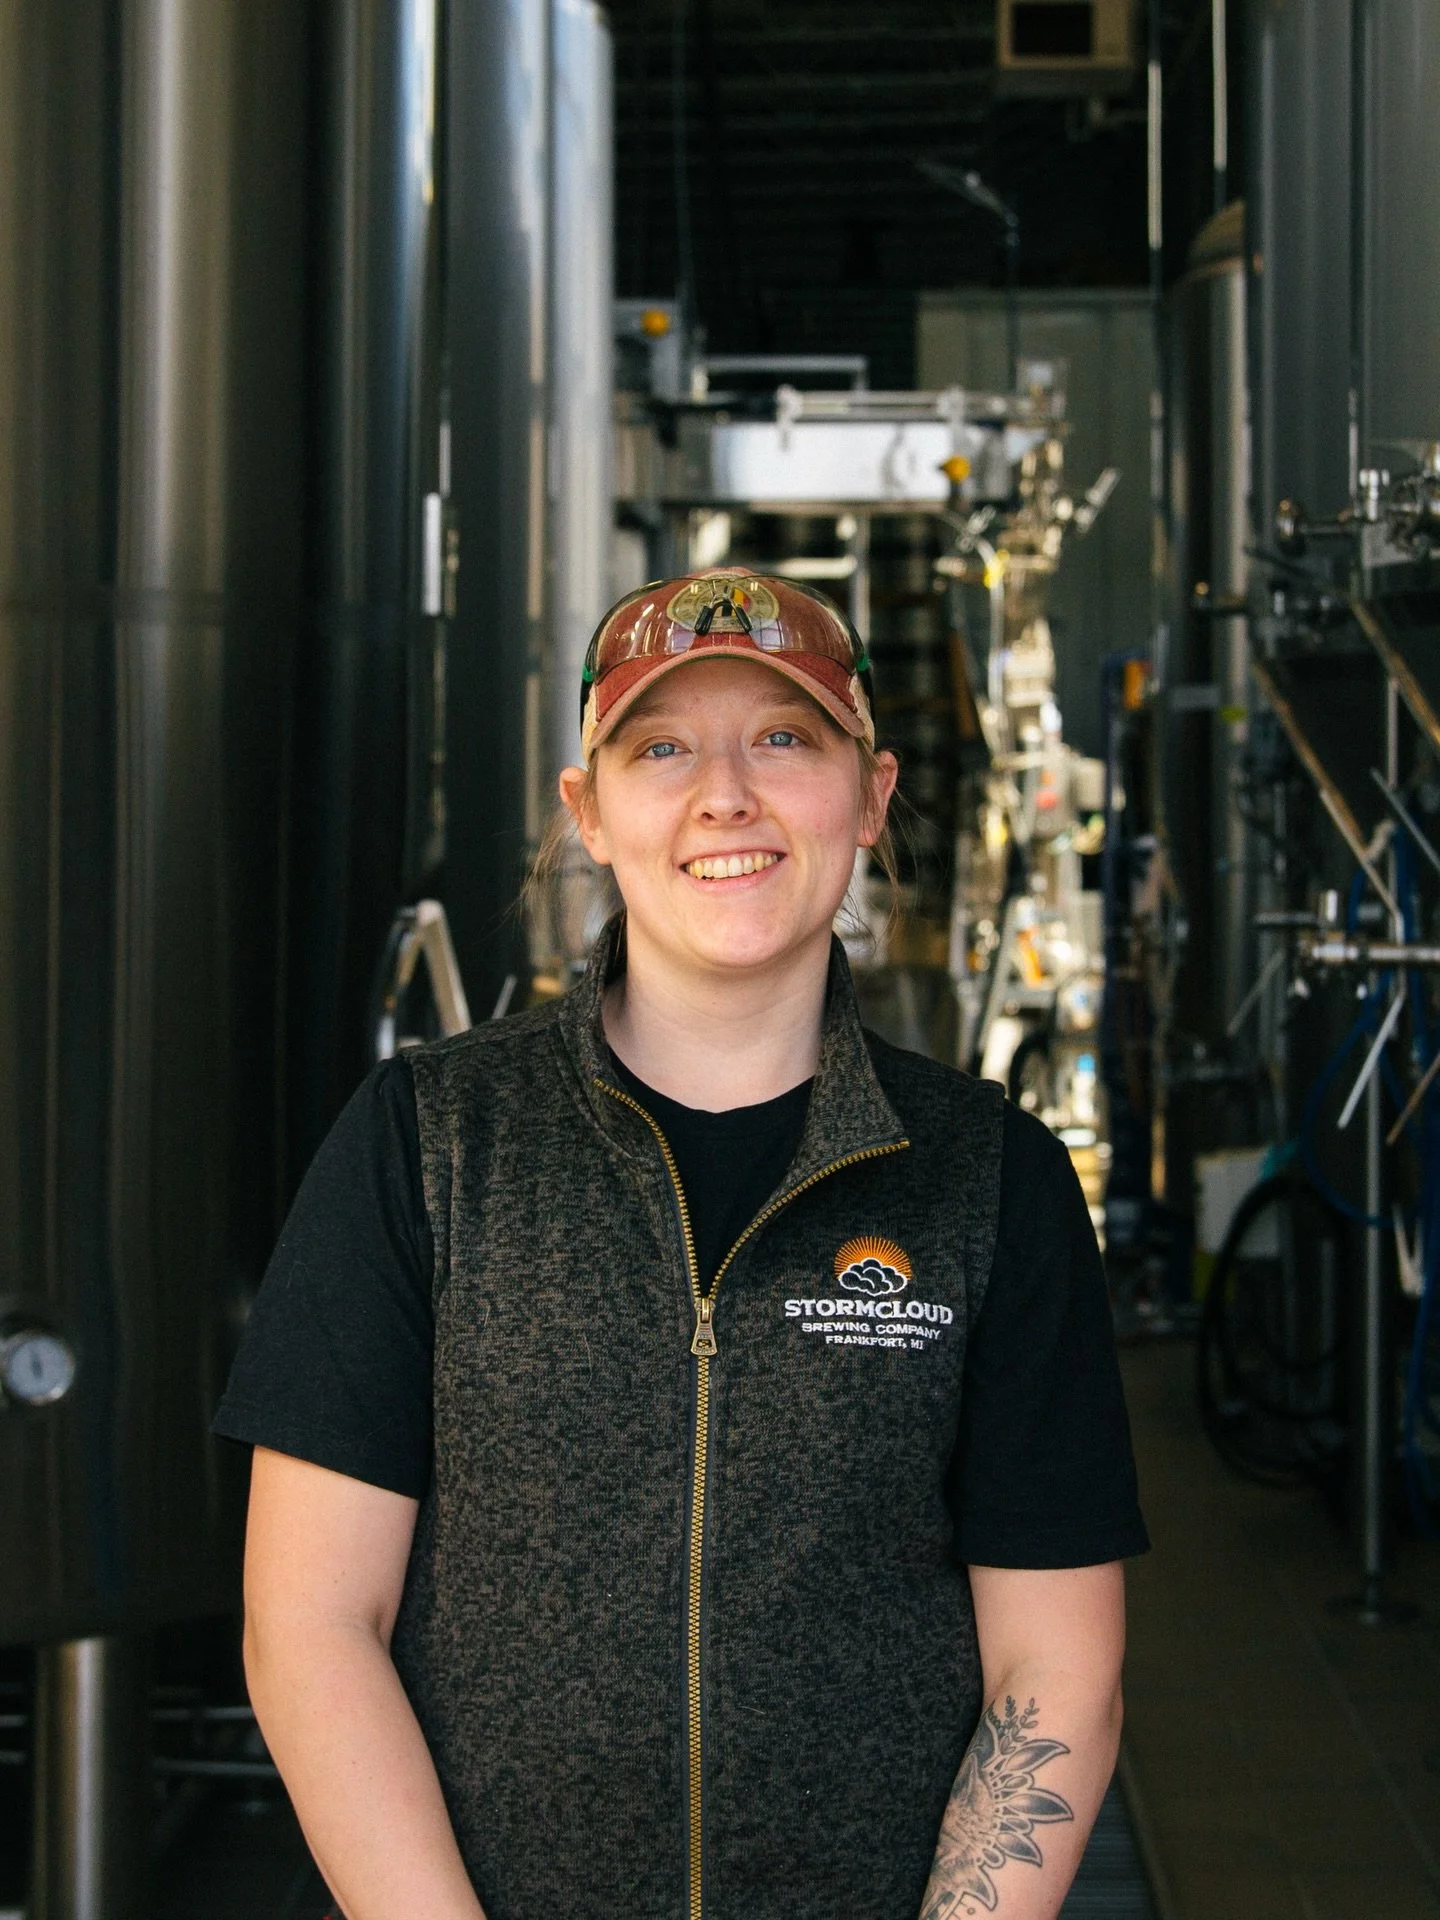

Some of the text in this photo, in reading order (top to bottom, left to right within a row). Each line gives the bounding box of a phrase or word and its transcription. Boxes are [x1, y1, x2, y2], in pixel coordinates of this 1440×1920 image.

[785, 1299, 953, 1324] STORMCLOUD
[802, 1322, 941, 1340] BREWING COMPANY
[825, 1335, 924, 1350] FRANKFORT, MI
